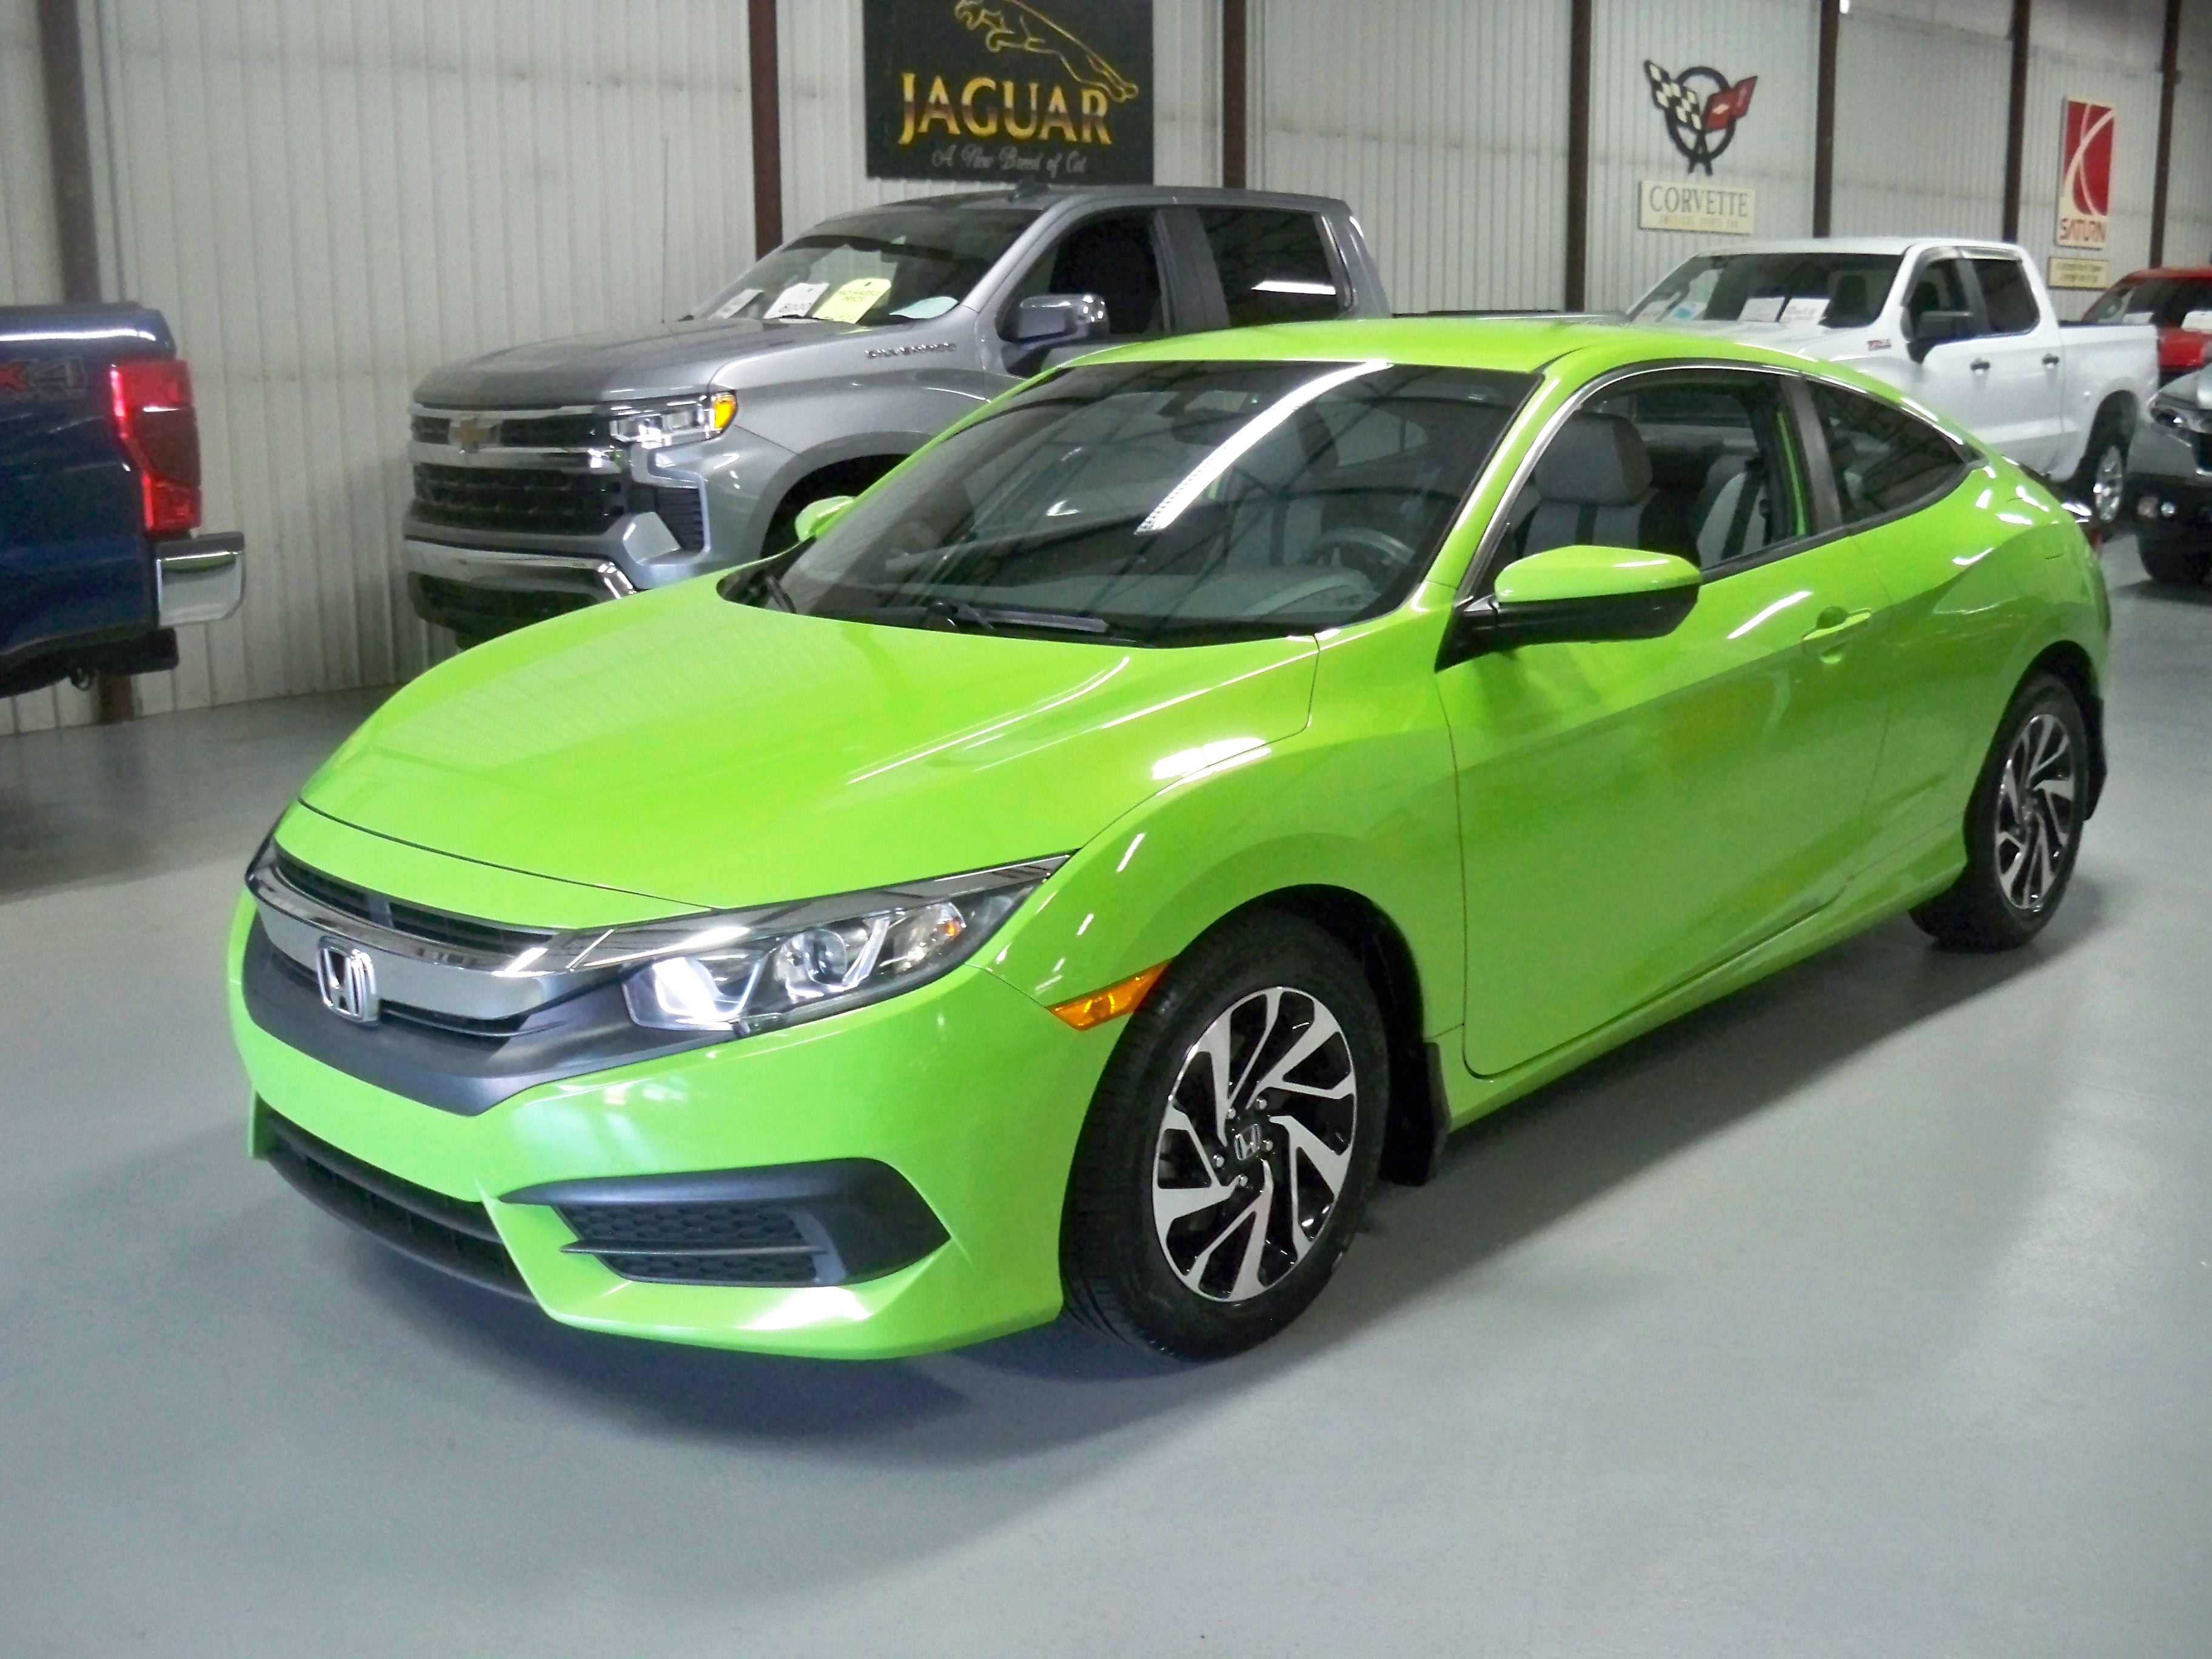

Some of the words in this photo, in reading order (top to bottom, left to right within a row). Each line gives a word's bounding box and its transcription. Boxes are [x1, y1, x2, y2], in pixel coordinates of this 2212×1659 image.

[899, 72, 1112, 145] JAGUAR
[1649, 185, 1749, 217] CORVETTE
[2059, 218, 2106, 243] SATURN
